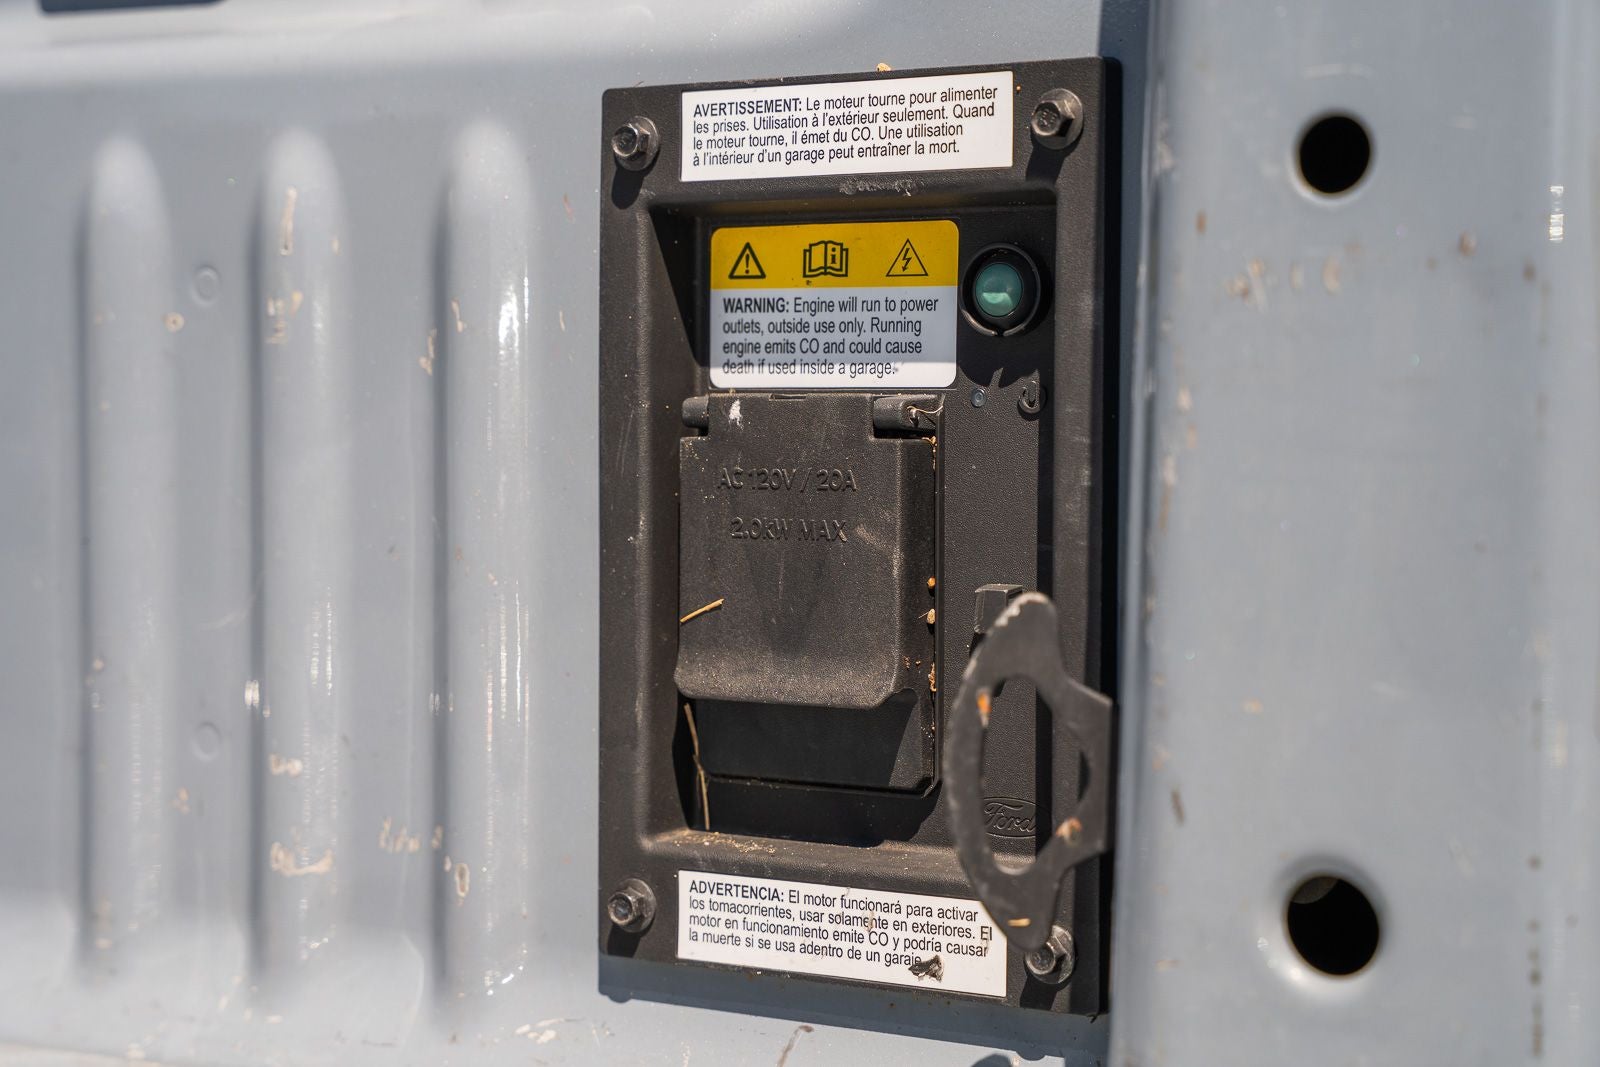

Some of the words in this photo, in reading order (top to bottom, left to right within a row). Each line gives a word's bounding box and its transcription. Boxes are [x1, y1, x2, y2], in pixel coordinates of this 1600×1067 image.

[694, 98, 801, 117] AVERTISSEMENT:
[807, 98, 820, 110] Le
[825, 96, 864, 109] moteur
[868, 94, 905, 106] tourne
[910, 92, 936, 108] pour
[941, 86, 997, 102] alimenter
[694, 121, 708, 134] les
[714, 119, 748, 136] prises.
[754, 115, 808, 130] Utilisation
[812, 113, 818, 127] à
[823, 111, 879, 126] l'extérieur
[883, 106, 948, 122] seulement.
[953, 102, 994, 118] Quand
[694, 137, 702, 150] le
[707, 136, 745, 149] moteur
[749, 134, 787, 146] tourne,
[792, 131, 797, 144] il
[801, 130, 829, 144] émet
[833, 129, 847, 142] du
[852, 127, 873, 141] CO.
[879, 126, 902, 140] Une
[907, 122, 962, 138] utilisation
[693, 153, 699, 166] à
[704, 151, 754, 165] l'intérieur
[758, 149, 781, 162] d'un
[786, 150, 824, 165] garage
[829, 145, 854, 162] peut
[858, 142, 911, 158] entraîner
[915, 141, 924, 154] la
[930, 140, 959, 153] mort.
[723, 298, 788, 313] WARNING:
[794, 297, 834, 317] Engine
[838, 297, 857, 312] will
[862, 300, 880, 312] run
[885, 297, 896, 312] to
[900, 299, 938, 315] power
[723, 319, 763, 336] outlets,
[768, 318, 810, 333] outside
[814, 321, 835, 333] use
[839, 318, 866, 337] only.
[871, 317, 921, 336] Running
[723, 342, 761, 358] engine
[765, 338, 796, 354] emits
[800, 338, 819, 354] CO
[823, 338, 845, 354] and
[849, 338, 881, 354] could
[886, 342, 922, 353] cause
[722, 360, 754, 375] death
[758, 359, 765, 375] if
[769, 359, 796, 375] used
[800, 358, 834, 375] inside
[839, 361, 846, 374] a
[849, 359, 895, 378] garage.
[718, 468, 743, 489] AC
[749, 468, 796, 490] 120V
[817, 468, 857, 492] 20A
[799, 519, 847, 542] MAX
[984, 803, 1036, 832] Ford
[690, 880, 783, 902] ADVERTENCIA:
[789, 890, 799, 903] El
[804, 894, 836, 907] motor
[840, 895, 901, 914] funcionará
[907, 905, 932, 918] para
[938, 907, 978, 922] activar
[690, 896, 704, 910] los
[709, 898, 794, 922] tomacorrientes,
[800, 911, 824, 922] usar
[828, 912, 888, 929] solamente
[893, 920, 907, 931] en
[912, 921, 974, 940] exteriores.
[981, 926, 992, 940] El
[690, 914, 721, 927] motor
[725, 919, 738, 929] en
[743, 919, 829, 938] funcionamiento
[833, 929, 864, 944] emite
[869, 931, 888, 946] CO
[893, 937, 899, 951] y
[904, 937, 941, 952] podría
[946, 943, 988, 957] causar
[690, 928, 698, 941] la
[703, 933, 740, 946] muerte
[745, 934, 753, 947] si
[758, 939, 771, 949] se
[776, 941, 795, 952] usa
[800, 941, 843, 958] adentro
[848, 946, 861, 960] de
[866, 951, 880, 962] un
